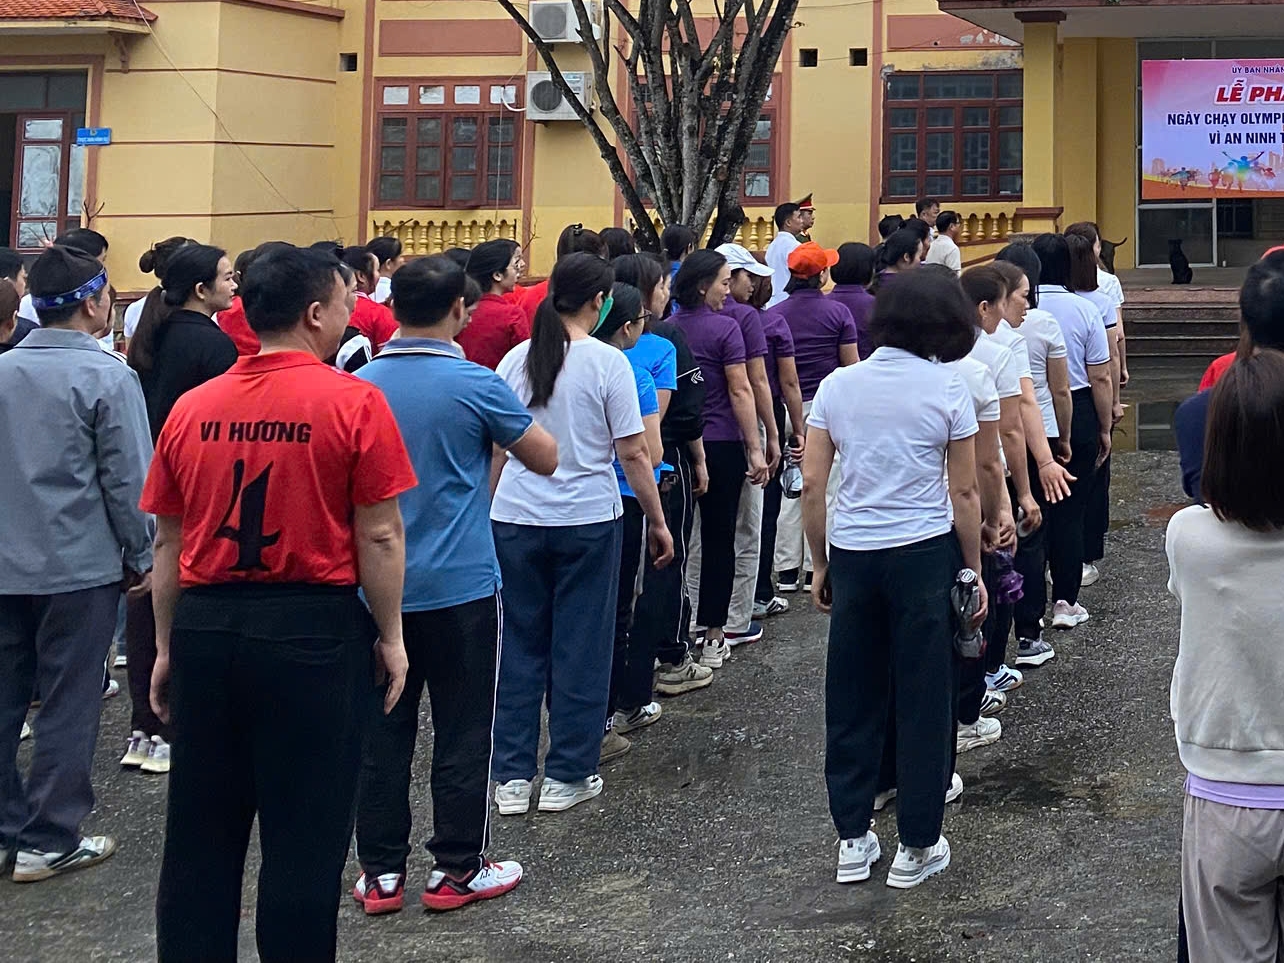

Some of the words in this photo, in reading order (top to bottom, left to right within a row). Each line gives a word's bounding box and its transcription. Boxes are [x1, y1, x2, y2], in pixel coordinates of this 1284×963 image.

[1216, 79, 1245, 102] LỄ
[1167, 111, 1201, 125] NGÀY
[1204, 113, 1237, 127] CHẠY
[1209, 130, 1221, 144] VÌ
[1224, 132, 1242, 144] AN
[1245, 132, 1276, 144] NINH
[201, 421, 221, 442] VI
[228, 420, 312, 444] HƯƠNG
[213, 458, 281, 571] 4
